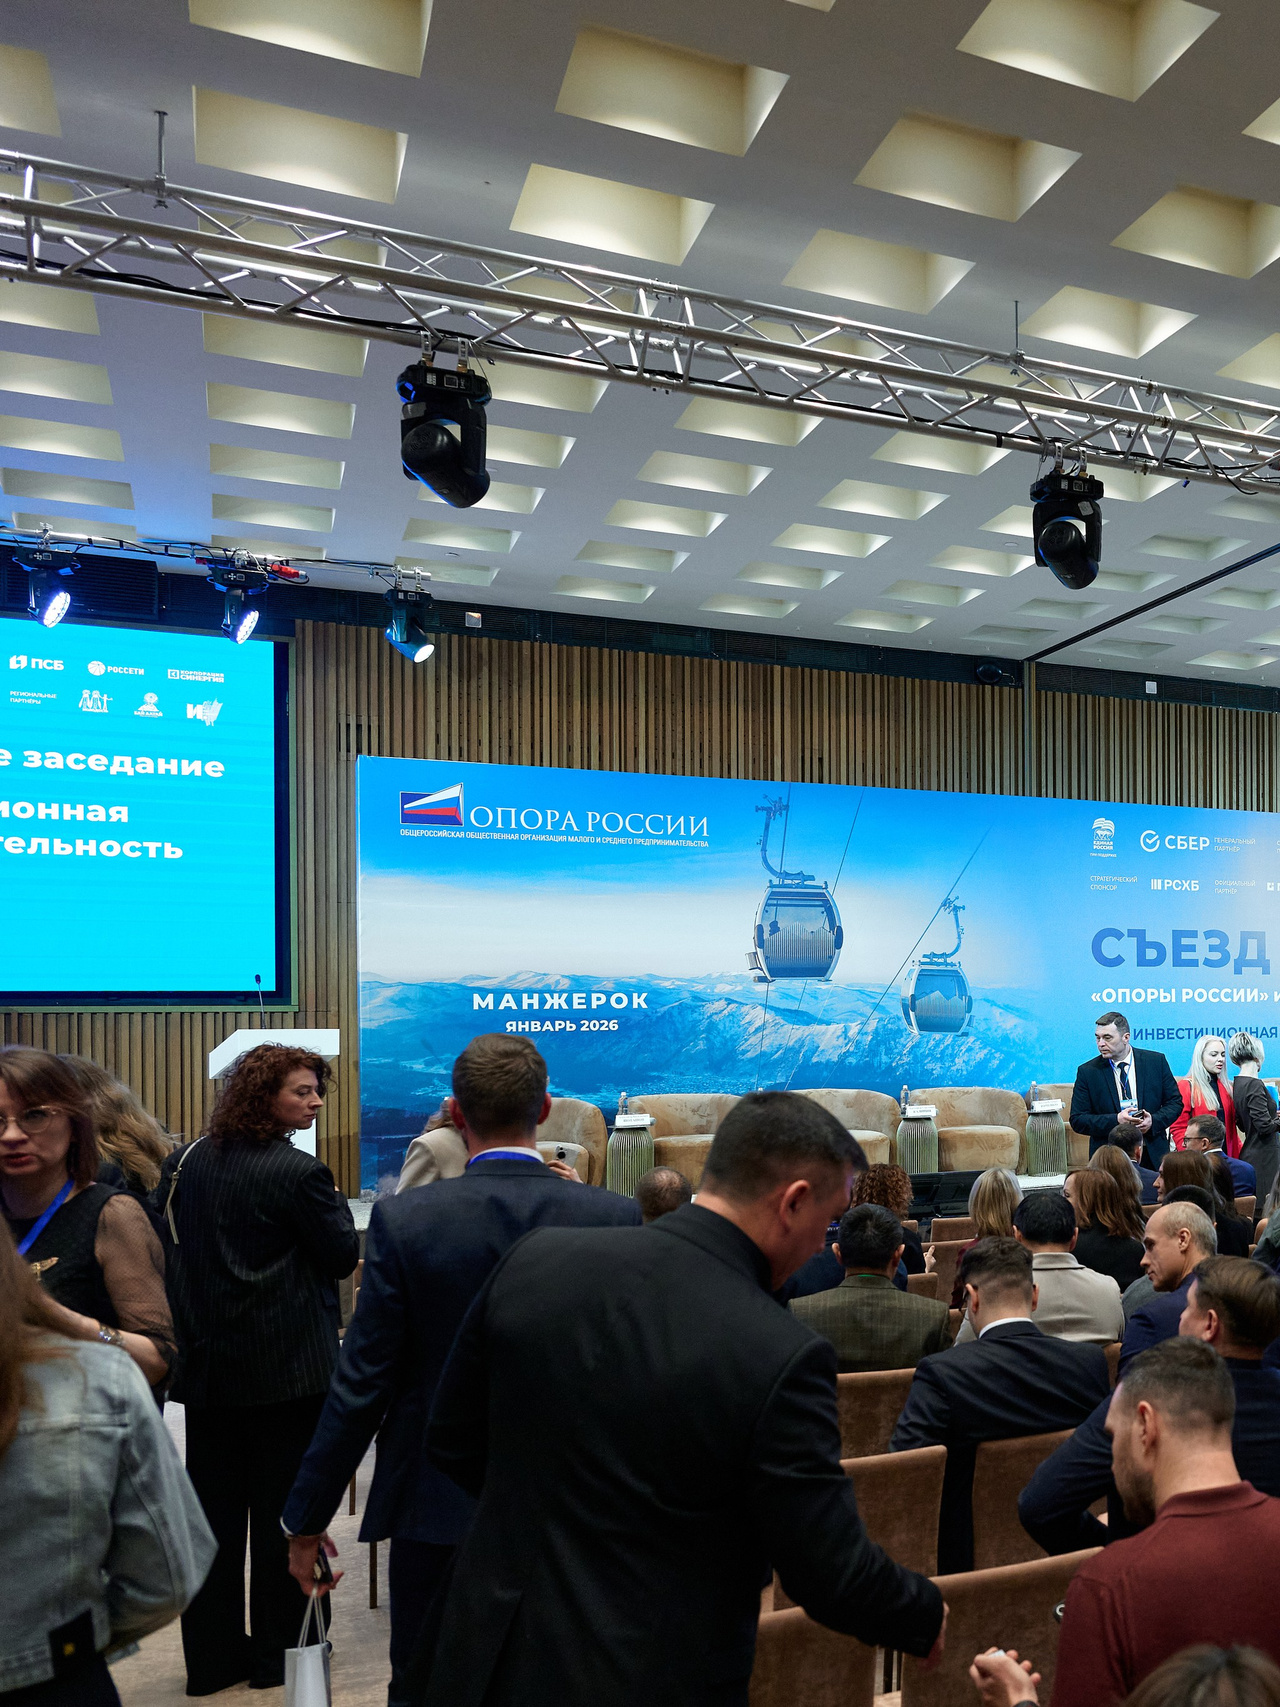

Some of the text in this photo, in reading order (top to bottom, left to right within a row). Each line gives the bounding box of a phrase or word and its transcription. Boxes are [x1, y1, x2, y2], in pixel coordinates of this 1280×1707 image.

[32, 658, 64, 670] ПСБ
[108, 666, 145, 675] РОССЕТИ
[180, 675, 224, 683] СИНЕРГИЯ
[10, 691, 57, 699] РЕГИОНАЛЬНЫЕ
[23, 750, 225, 778] заседание
[470, 806, 709, 837] ОПОРА РОССИИ
[400, 829, 465, 838] ОБЩЕРОССИЙСКАЯ
[466, 832, 520, 840] ОБЩЕСТВЕННАЯ
[521, 834, 567, 842] ОРГАНИЗАЦИЯ
[596, 836, 601, 844] И
[602, 837, 633, 845] СРЕДНЕГО
[634, 838, 709, 847] ПРЕДПРИНИМАТЕЛЬСТВА
[1165, 835, 1210, 851] СБЕР
[0, 836, 183, 859] ельность
[1164, 879, 1199, 891] РСХБ
[1092, 928, 1271, 975] СЪЕЗД
[473, 992, 648, 1010] МАНЖЕРОК
[1091, 988, 1176, 1003] «ОПОРЫ
[1182, 988, 1269, 1003] РОССИИ»
[505, 1020, 619, 1032] ЯНВАРЬ 2026
